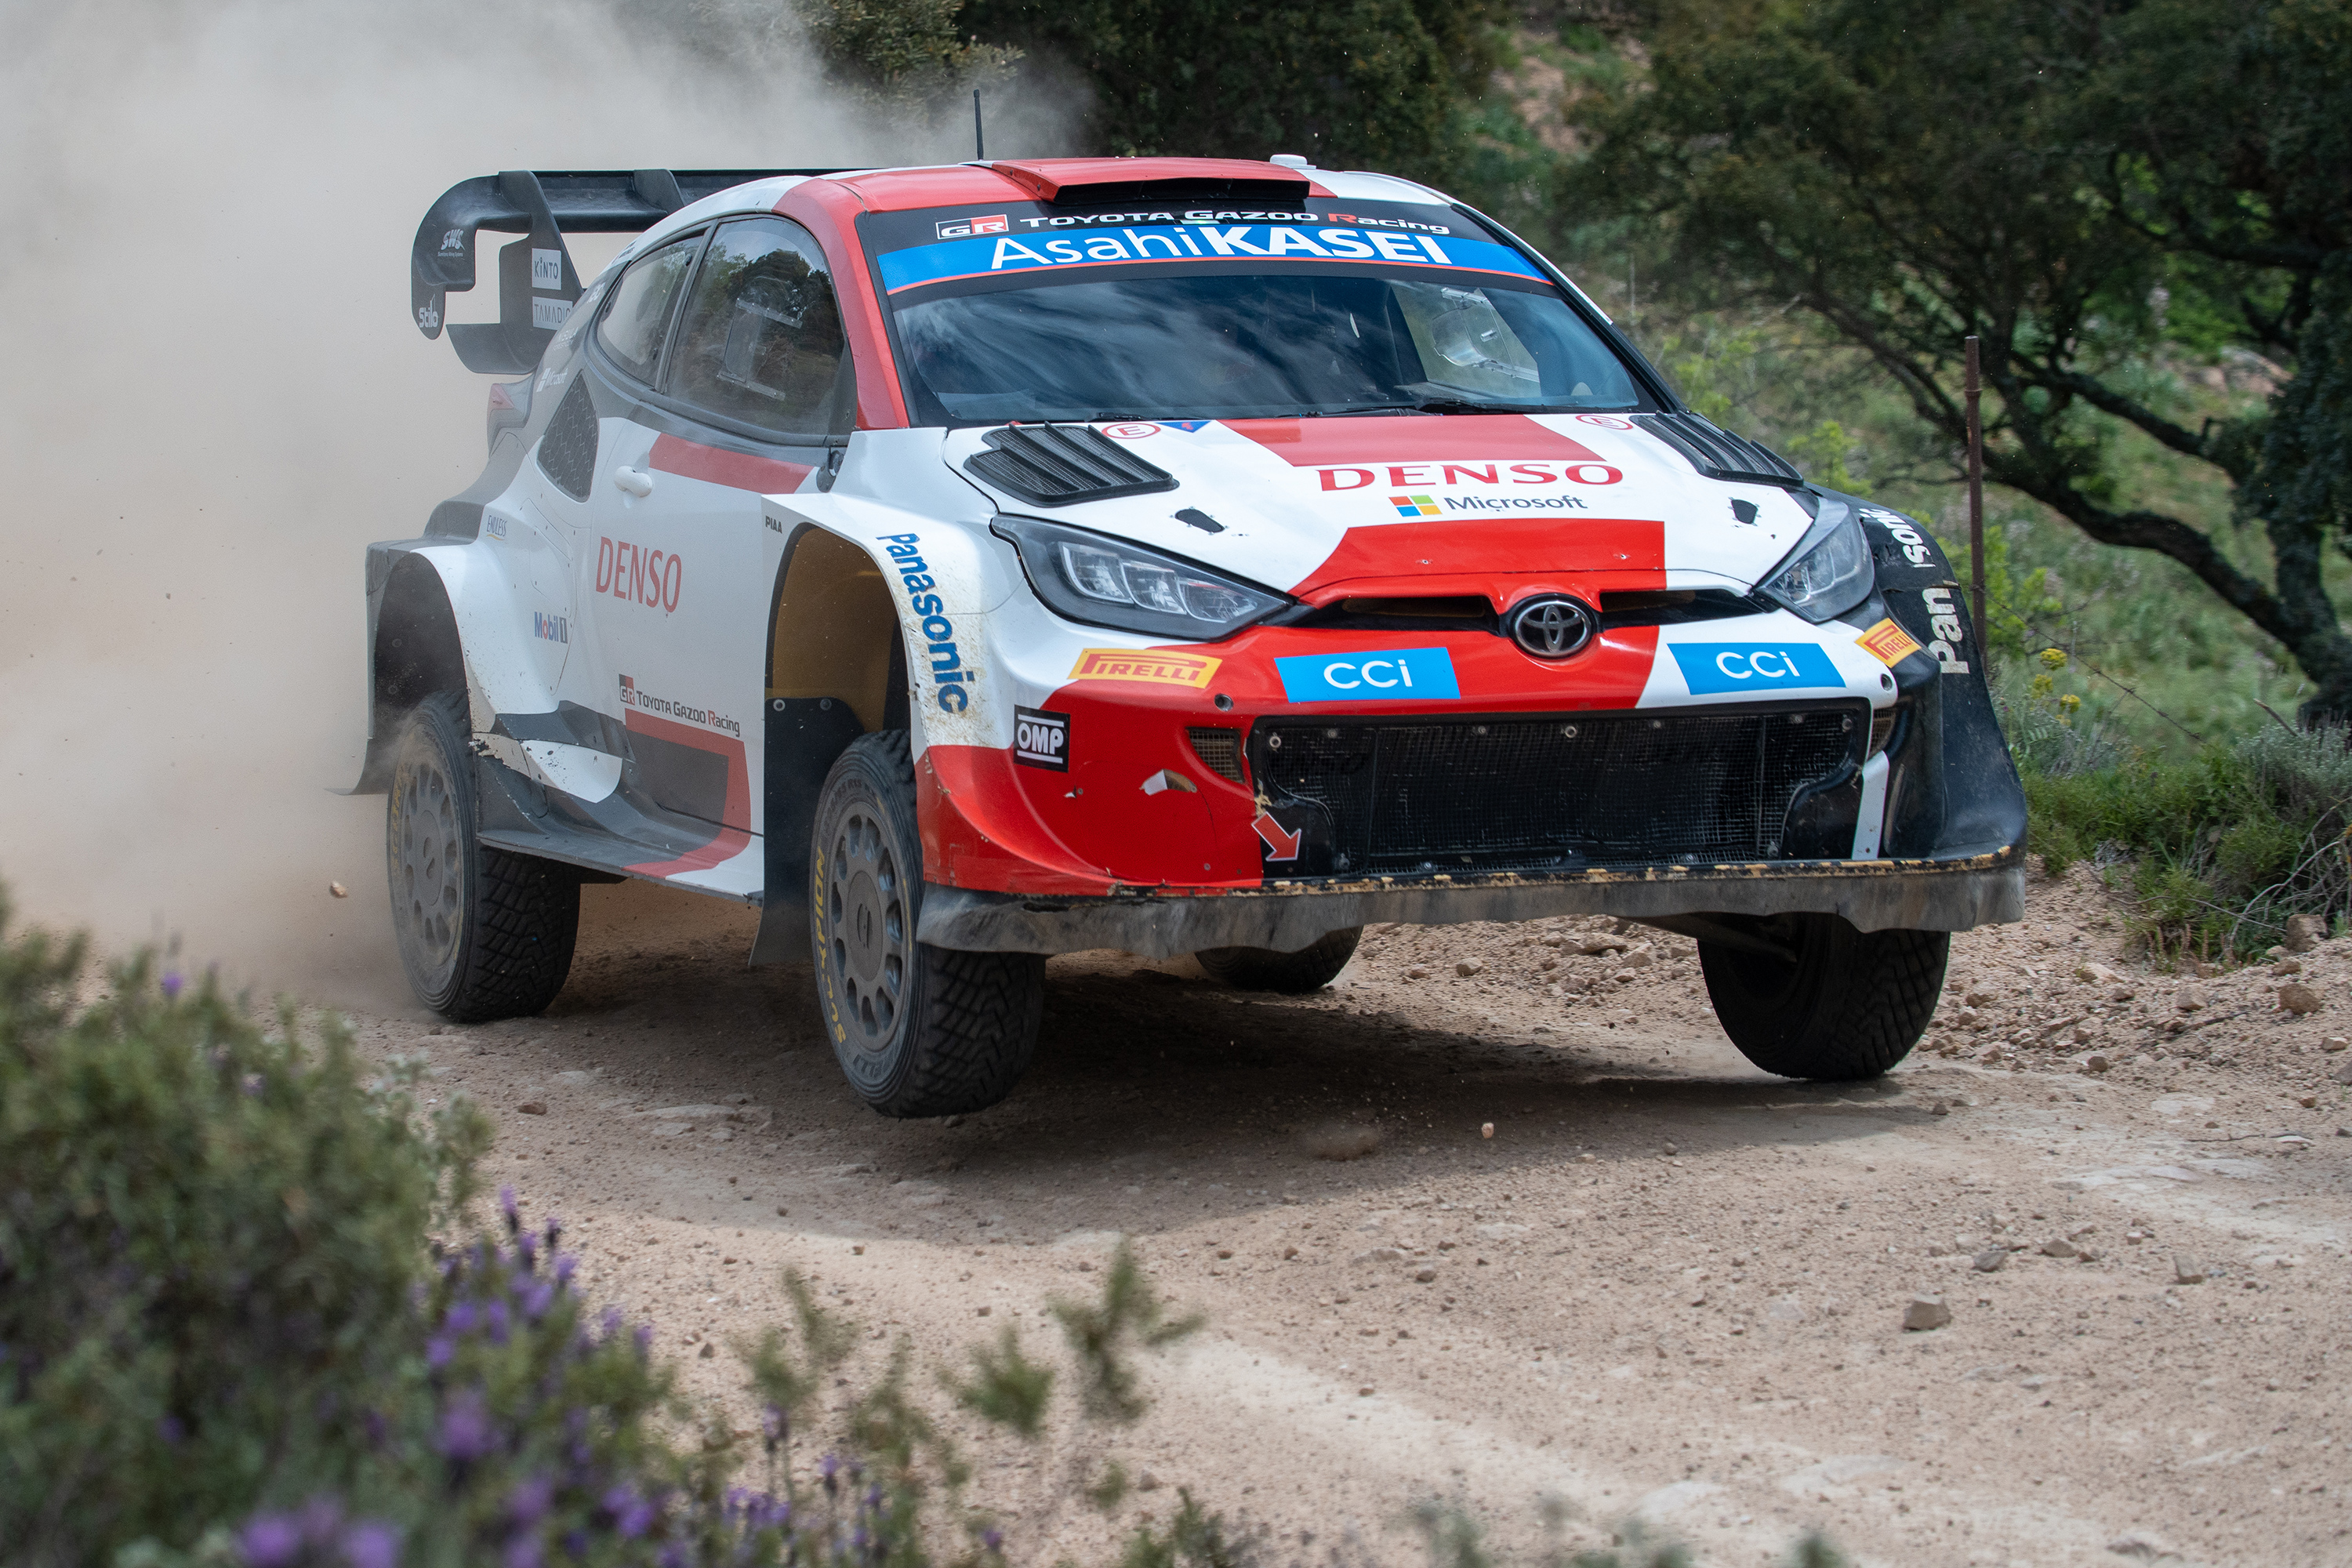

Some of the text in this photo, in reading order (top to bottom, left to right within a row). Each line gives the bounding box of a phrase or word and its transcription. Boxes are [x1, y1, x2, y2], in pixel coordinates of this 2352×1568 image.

[1019, 212, 1175, 228] TOYOTA
[1184, 210, 1319, 222] GAZOO
[1327, 212, 1450, 235] Racing
[419, 293, 439, 328] Stilo
[1317, 463, 1624, 492] DENSO
[1443, 495, 1588, 510] Microsoft
[765, 515, 782, 534] PIAA
[596, 535, 682, 613] DENSO
[876, 533, 975, 713] Panasonic
[1079, 653, 1208, 681] PIRELLI
[636, 690, 672, 715] TOYOTA
[673, 701, 706, 724] GAZOO
[707, 710, 741, 738] Racing
[1017, 722, 1064, 755] OMP
